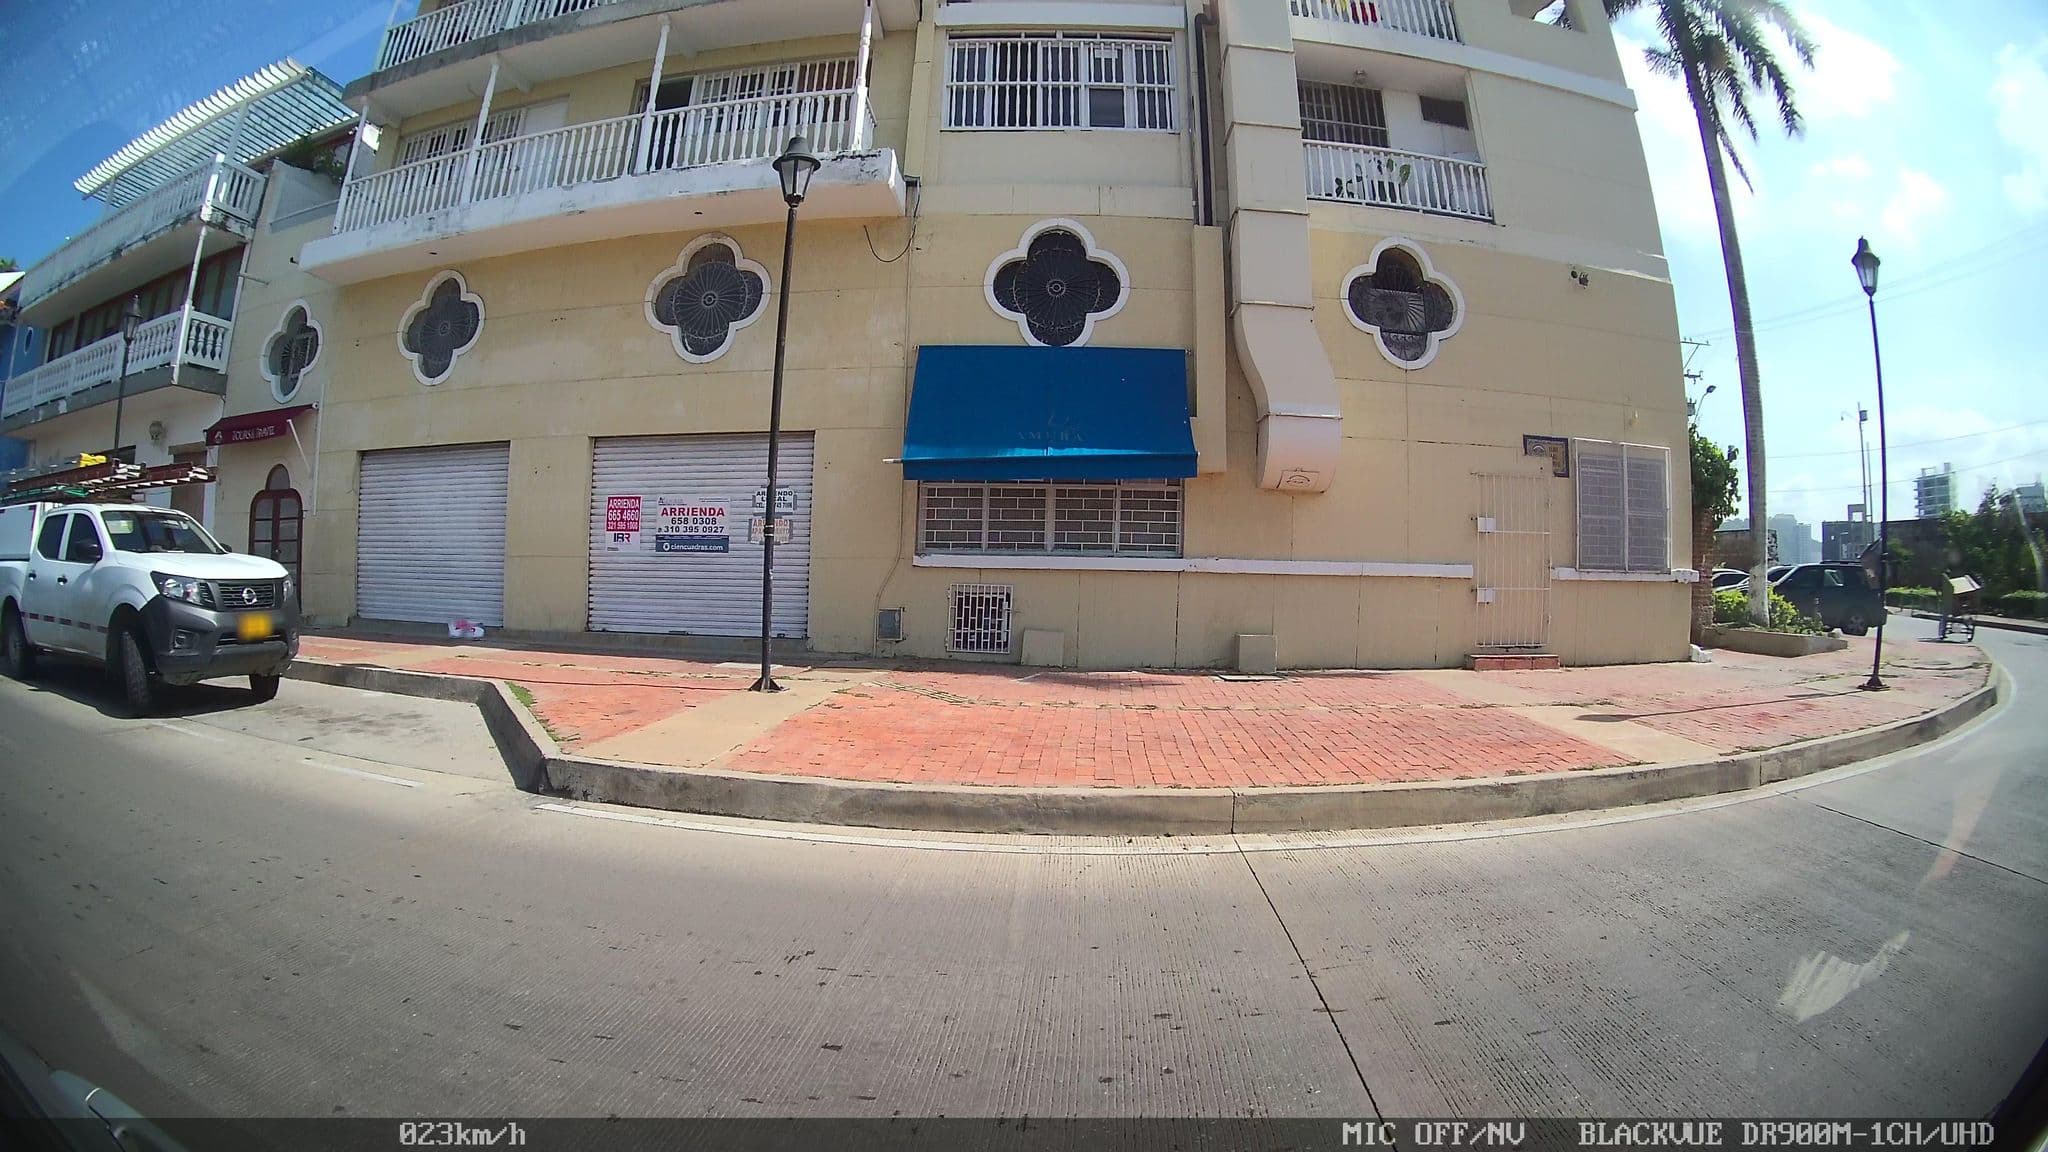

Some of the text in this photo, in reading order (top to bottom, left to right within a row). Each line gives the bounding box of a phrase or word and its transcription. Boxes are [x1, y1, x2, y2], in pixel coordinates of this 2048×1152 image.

[608, 498, 640, 508] ARRIENDA
[608, 509, 639, 521] 665 4660
[661, 507, 725, 516] ARRIENDA
[671, 517, 717, 525] 658 0308
